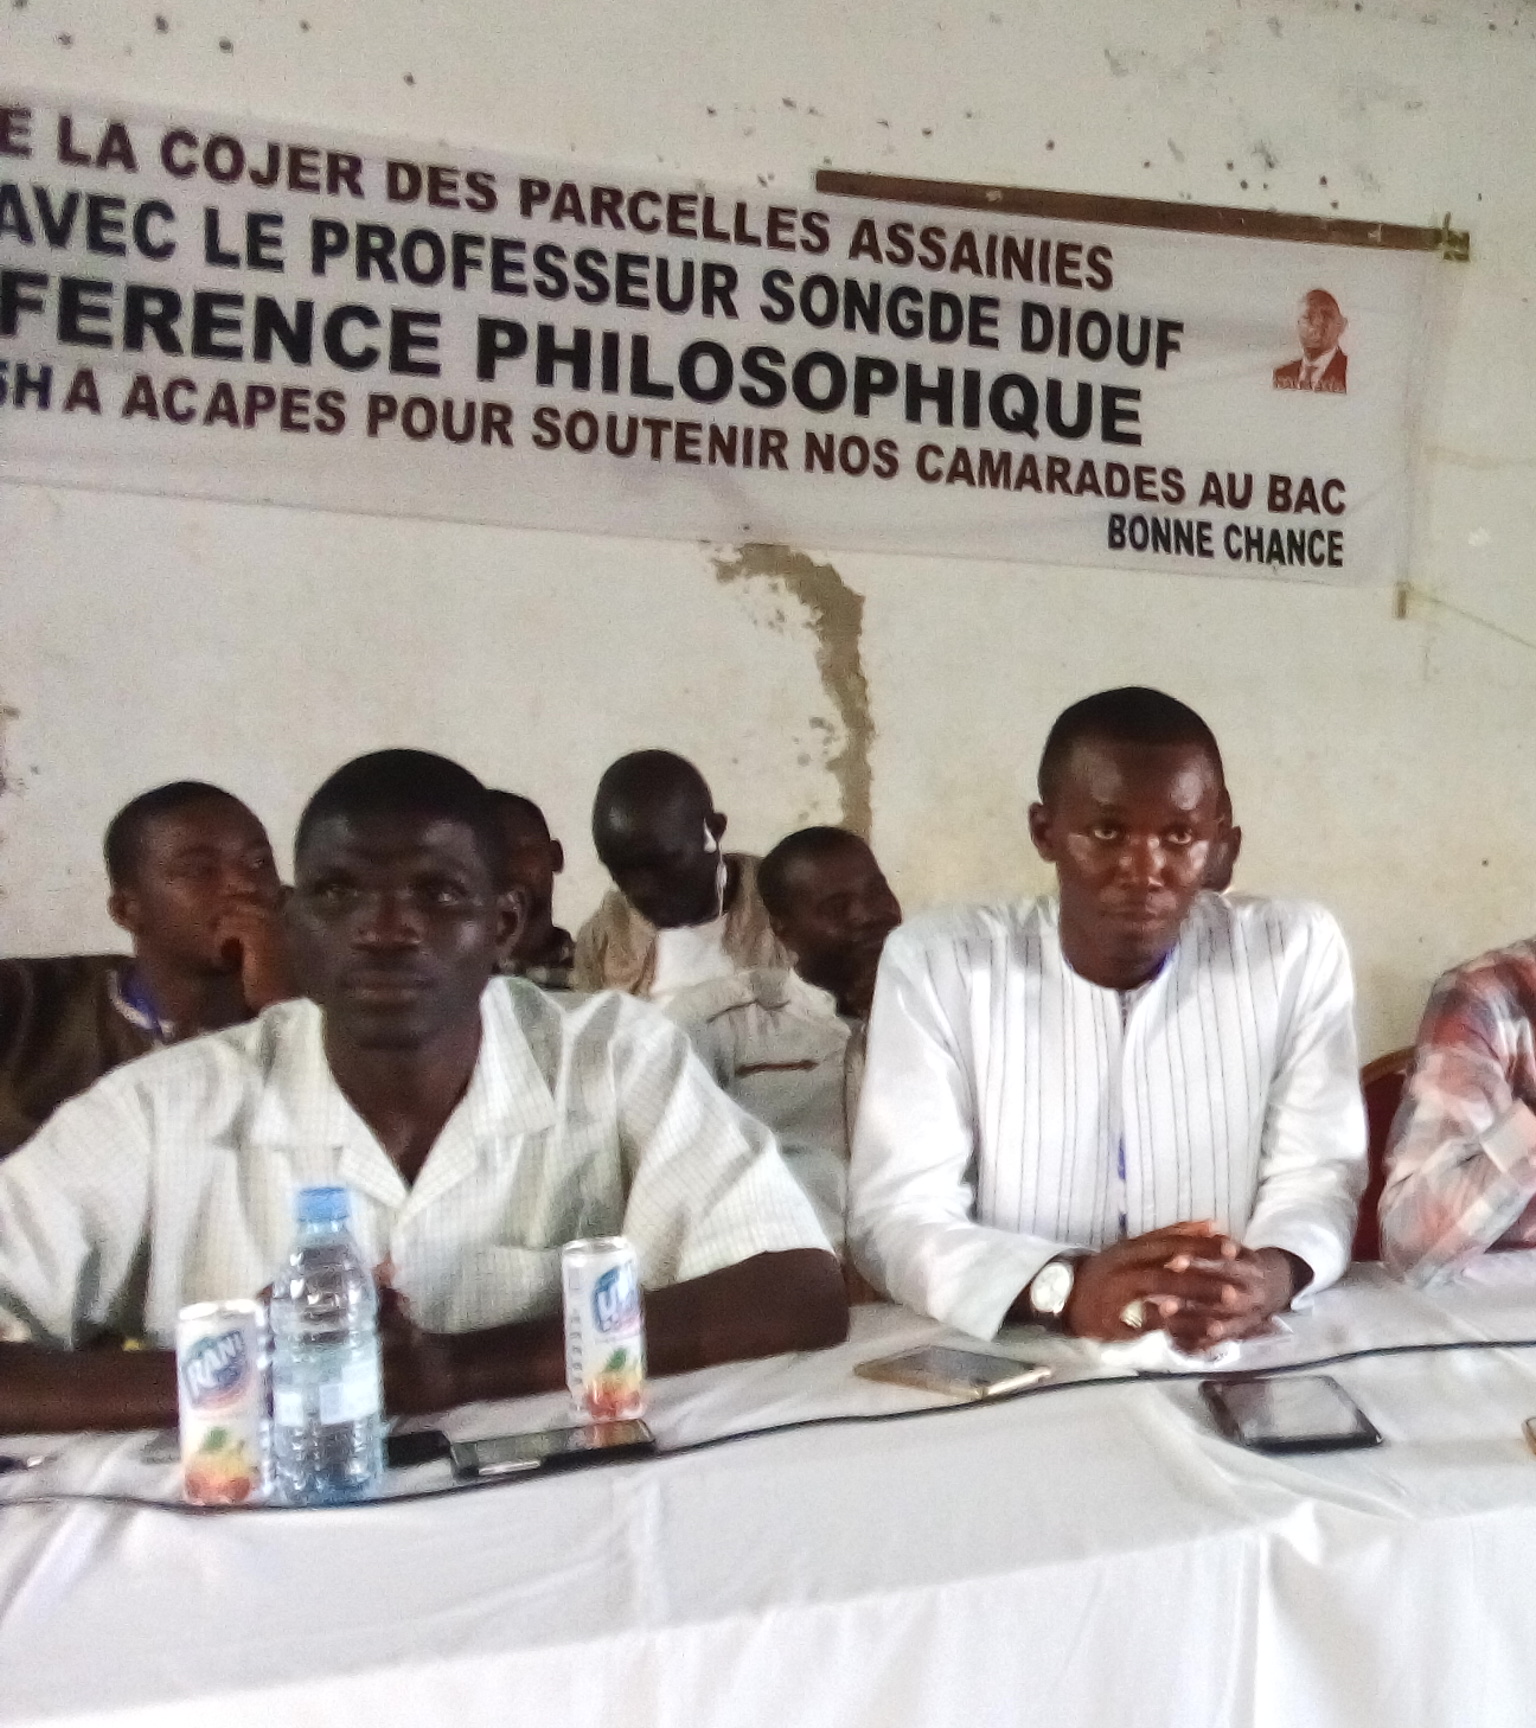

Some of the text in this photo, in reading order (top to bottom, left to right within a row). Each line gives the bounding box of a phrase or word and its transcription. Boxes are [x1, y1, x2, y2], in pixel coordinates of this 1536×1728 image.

[0, 182, 1185, 371] AVEC LE PROFESSEUR SONGDE DIOUF
[58, 115, 138, 174] LA
[160, 128, 364, 199] COJER
[387, 160, 498, 213] DES
[519, 178, 830, 256] PARCELLES
[849, 217, 1114, 292] ASSAINIES
[0, 264, 1142, 446] FERENCE PHILOSOPHIQUE
[63, 367, 101, 415] A
[122, 373, 346, 435] ACAPES
[367, 392, 513, 447] POUR
[532, 407, 789, 473] SOUTENIR
[805, 432, 899, 479] NOS
[916, 444, 1185, 505] CAMARADES
[1199, 472, 1253, 510] AU
[1268, 474, 1345, 515] BAC
[1108, 512, 1343, 567] BONNE CHANCE
